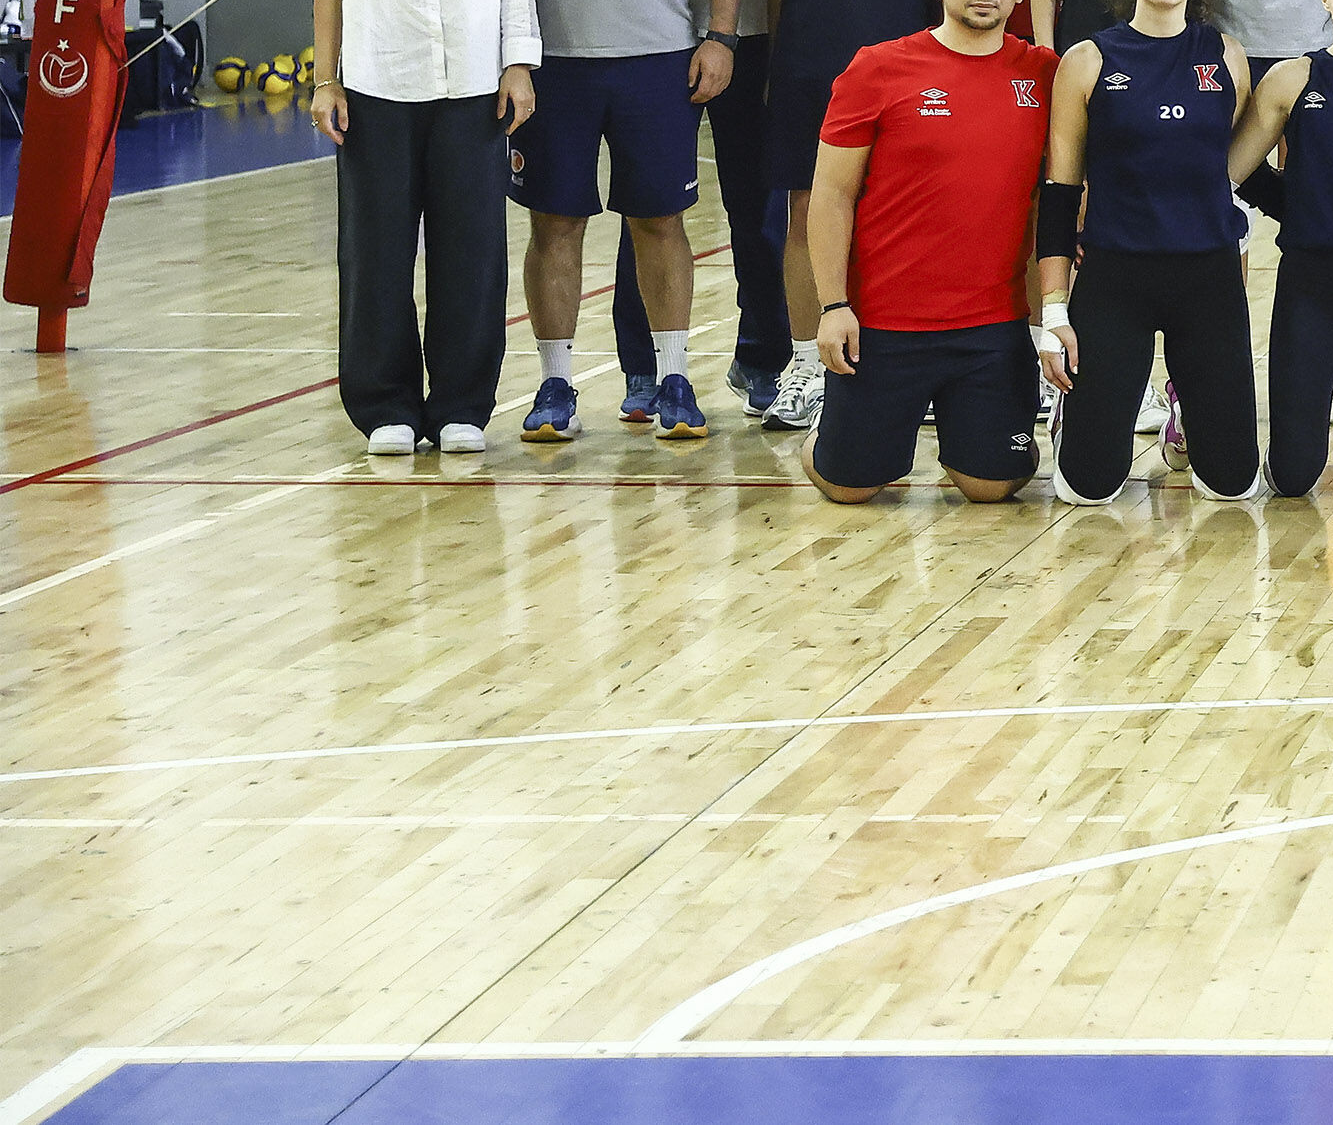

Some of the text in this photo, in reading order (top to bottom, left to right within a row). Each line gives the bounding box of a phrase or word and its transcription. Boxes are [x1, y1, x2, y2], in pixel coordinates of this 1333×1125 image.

[1194, 64, 1222, 91] K
[1011, 79, 1040, 107] K
[1159, 106, 1184, 119] 20
